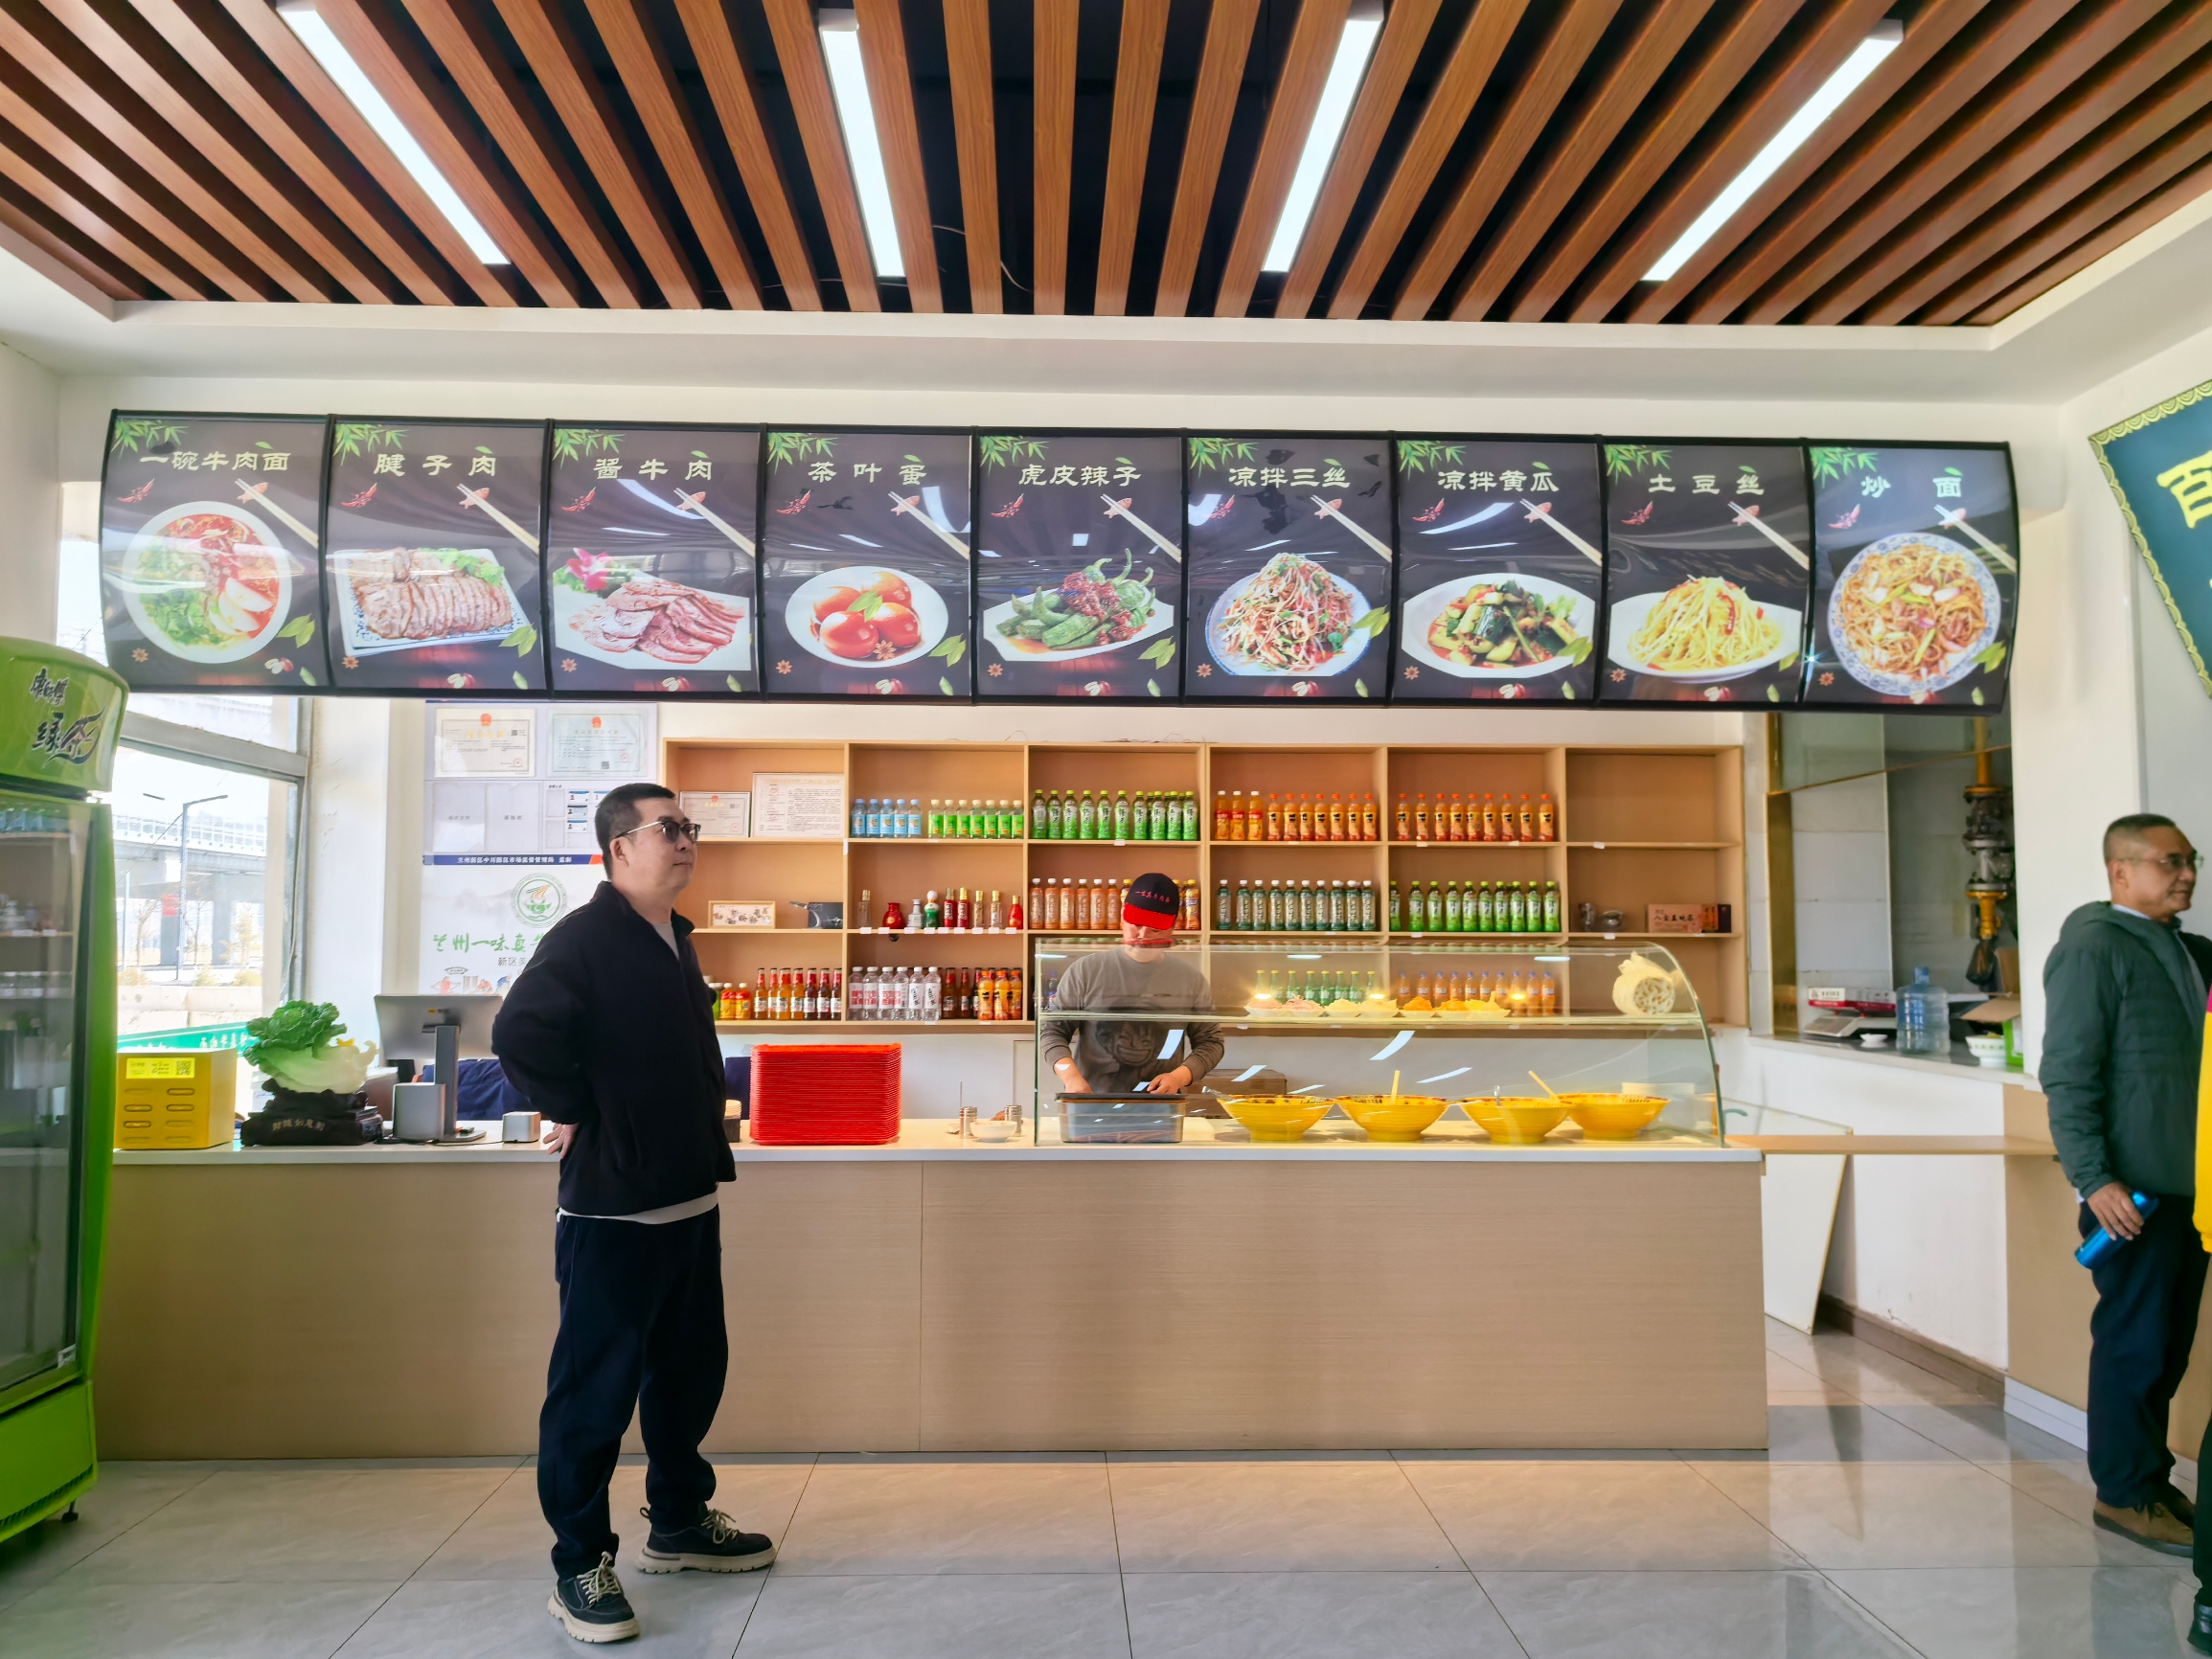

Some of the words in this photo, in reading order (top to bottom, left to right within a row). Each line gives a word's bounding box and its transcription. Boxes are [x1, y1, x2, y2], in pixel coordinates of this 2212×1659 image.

[140, 450, 291, 471] 一碗牛肉面
[373, 453, 497, 477] 腱子肉
[593, 458, 713, 481] 酱牛肉
[808, 462, 926, 486] 茶叶蛋
[1018, 464, 1142, 488] 虎皮辣子
[1228, 466, 1351, 489] 凉拌三丝
[1437, 470, 1560, 492] 凉拌黄瓜
[1648, 473, 1765, 496] 土豆丝
[1860, 475, 1962, 498] 炒面
